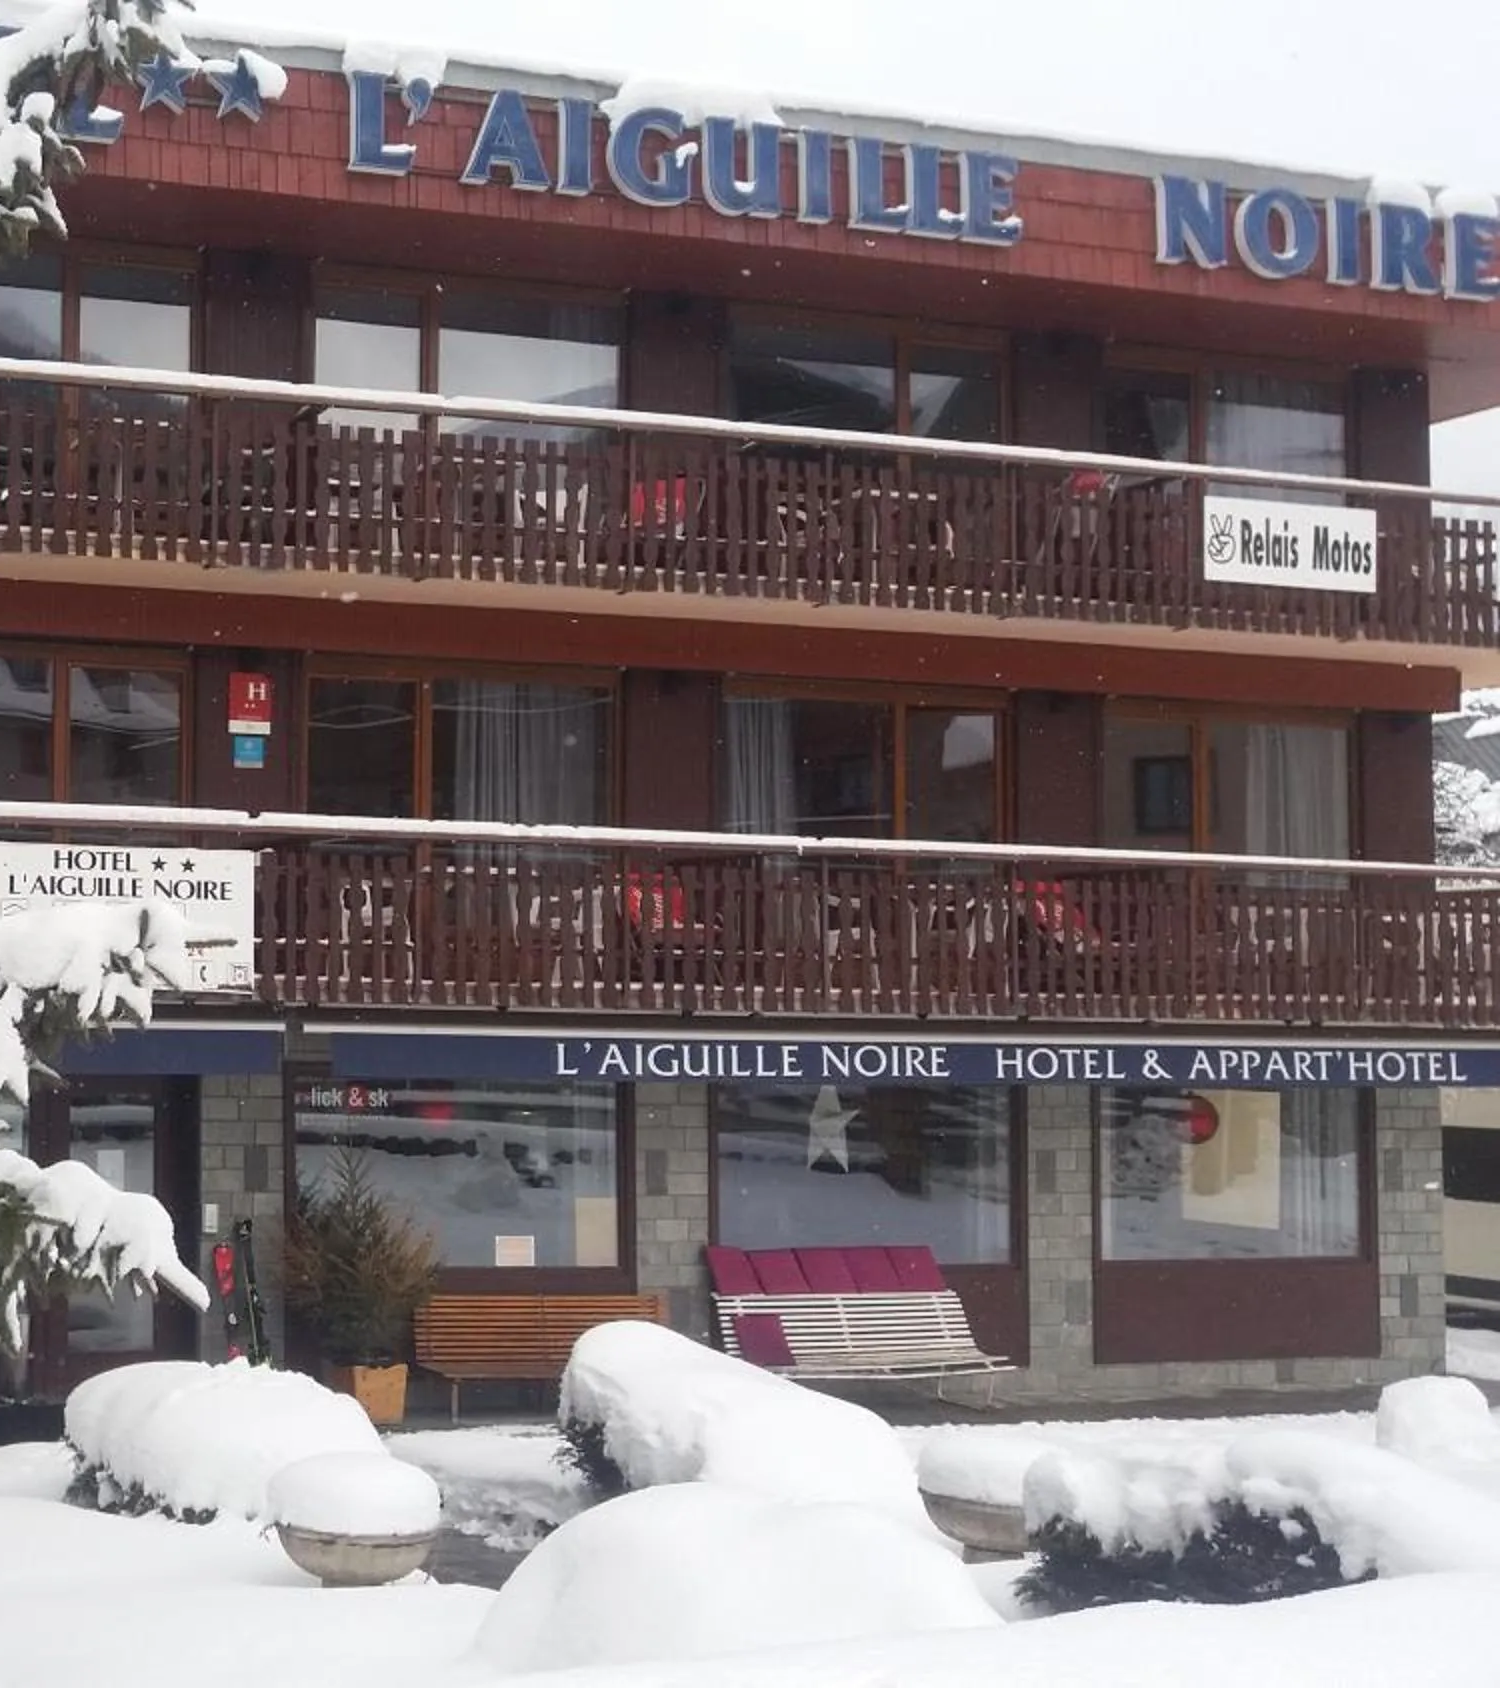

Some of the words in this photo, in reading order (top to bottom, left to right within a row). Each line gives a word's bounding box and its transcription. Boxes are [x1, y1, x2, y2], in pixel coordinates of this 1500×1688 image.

[347, 69, 1024, 246] L'AIGUILLE
[1153, 174, 1500, 301] NOIRE
[1240, 518, 1299, 569] Relais
[1312, 525, 1372, 575] Motos
[248, 681, 266, 701] H
[53, 849, 139, 872] HOTEL
[8, 874, 144, 898] L'AIGUILLE
[152, 879, 233, 901] NOIRE
[555, 1042, 804, 1078] L'AIGUILLE
[820, 1044, 951, 1078] NOIRE
[994, 1048, 1126, 1081] HOTEL
[1141, 1049, 1173, 1081] &
[1188, 1049, 1468, 1083] APPART'HOTEL
